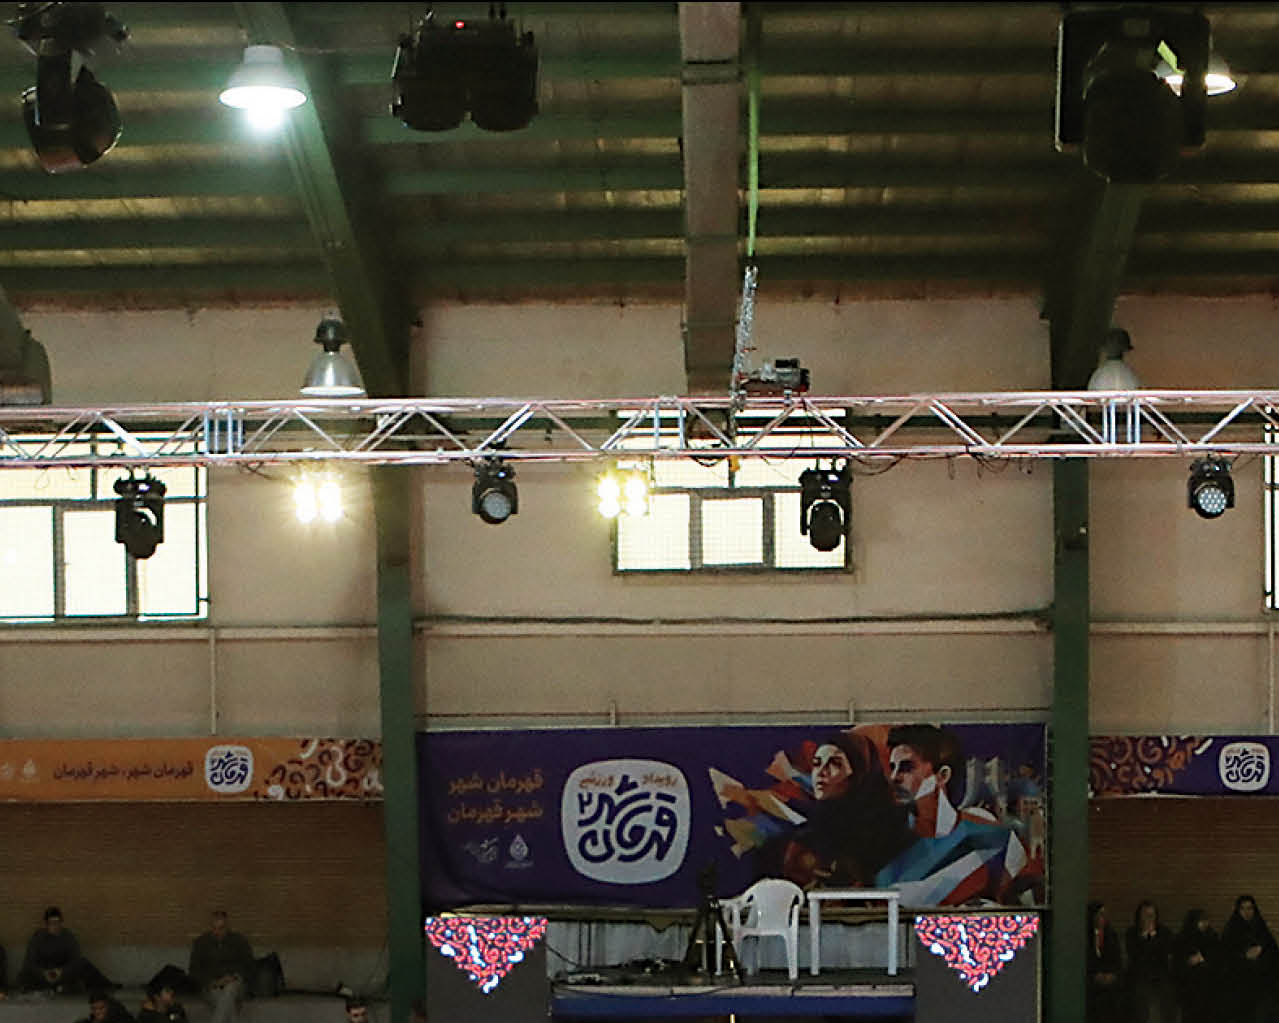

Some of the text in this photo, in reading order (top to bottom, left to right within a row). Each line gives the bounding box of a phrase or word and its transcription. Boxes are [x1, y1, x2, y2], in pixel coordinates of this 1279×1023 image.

[447, 768, 545, 797] قهرمان شهر
[447, 800, 504, 825] قهرمان
